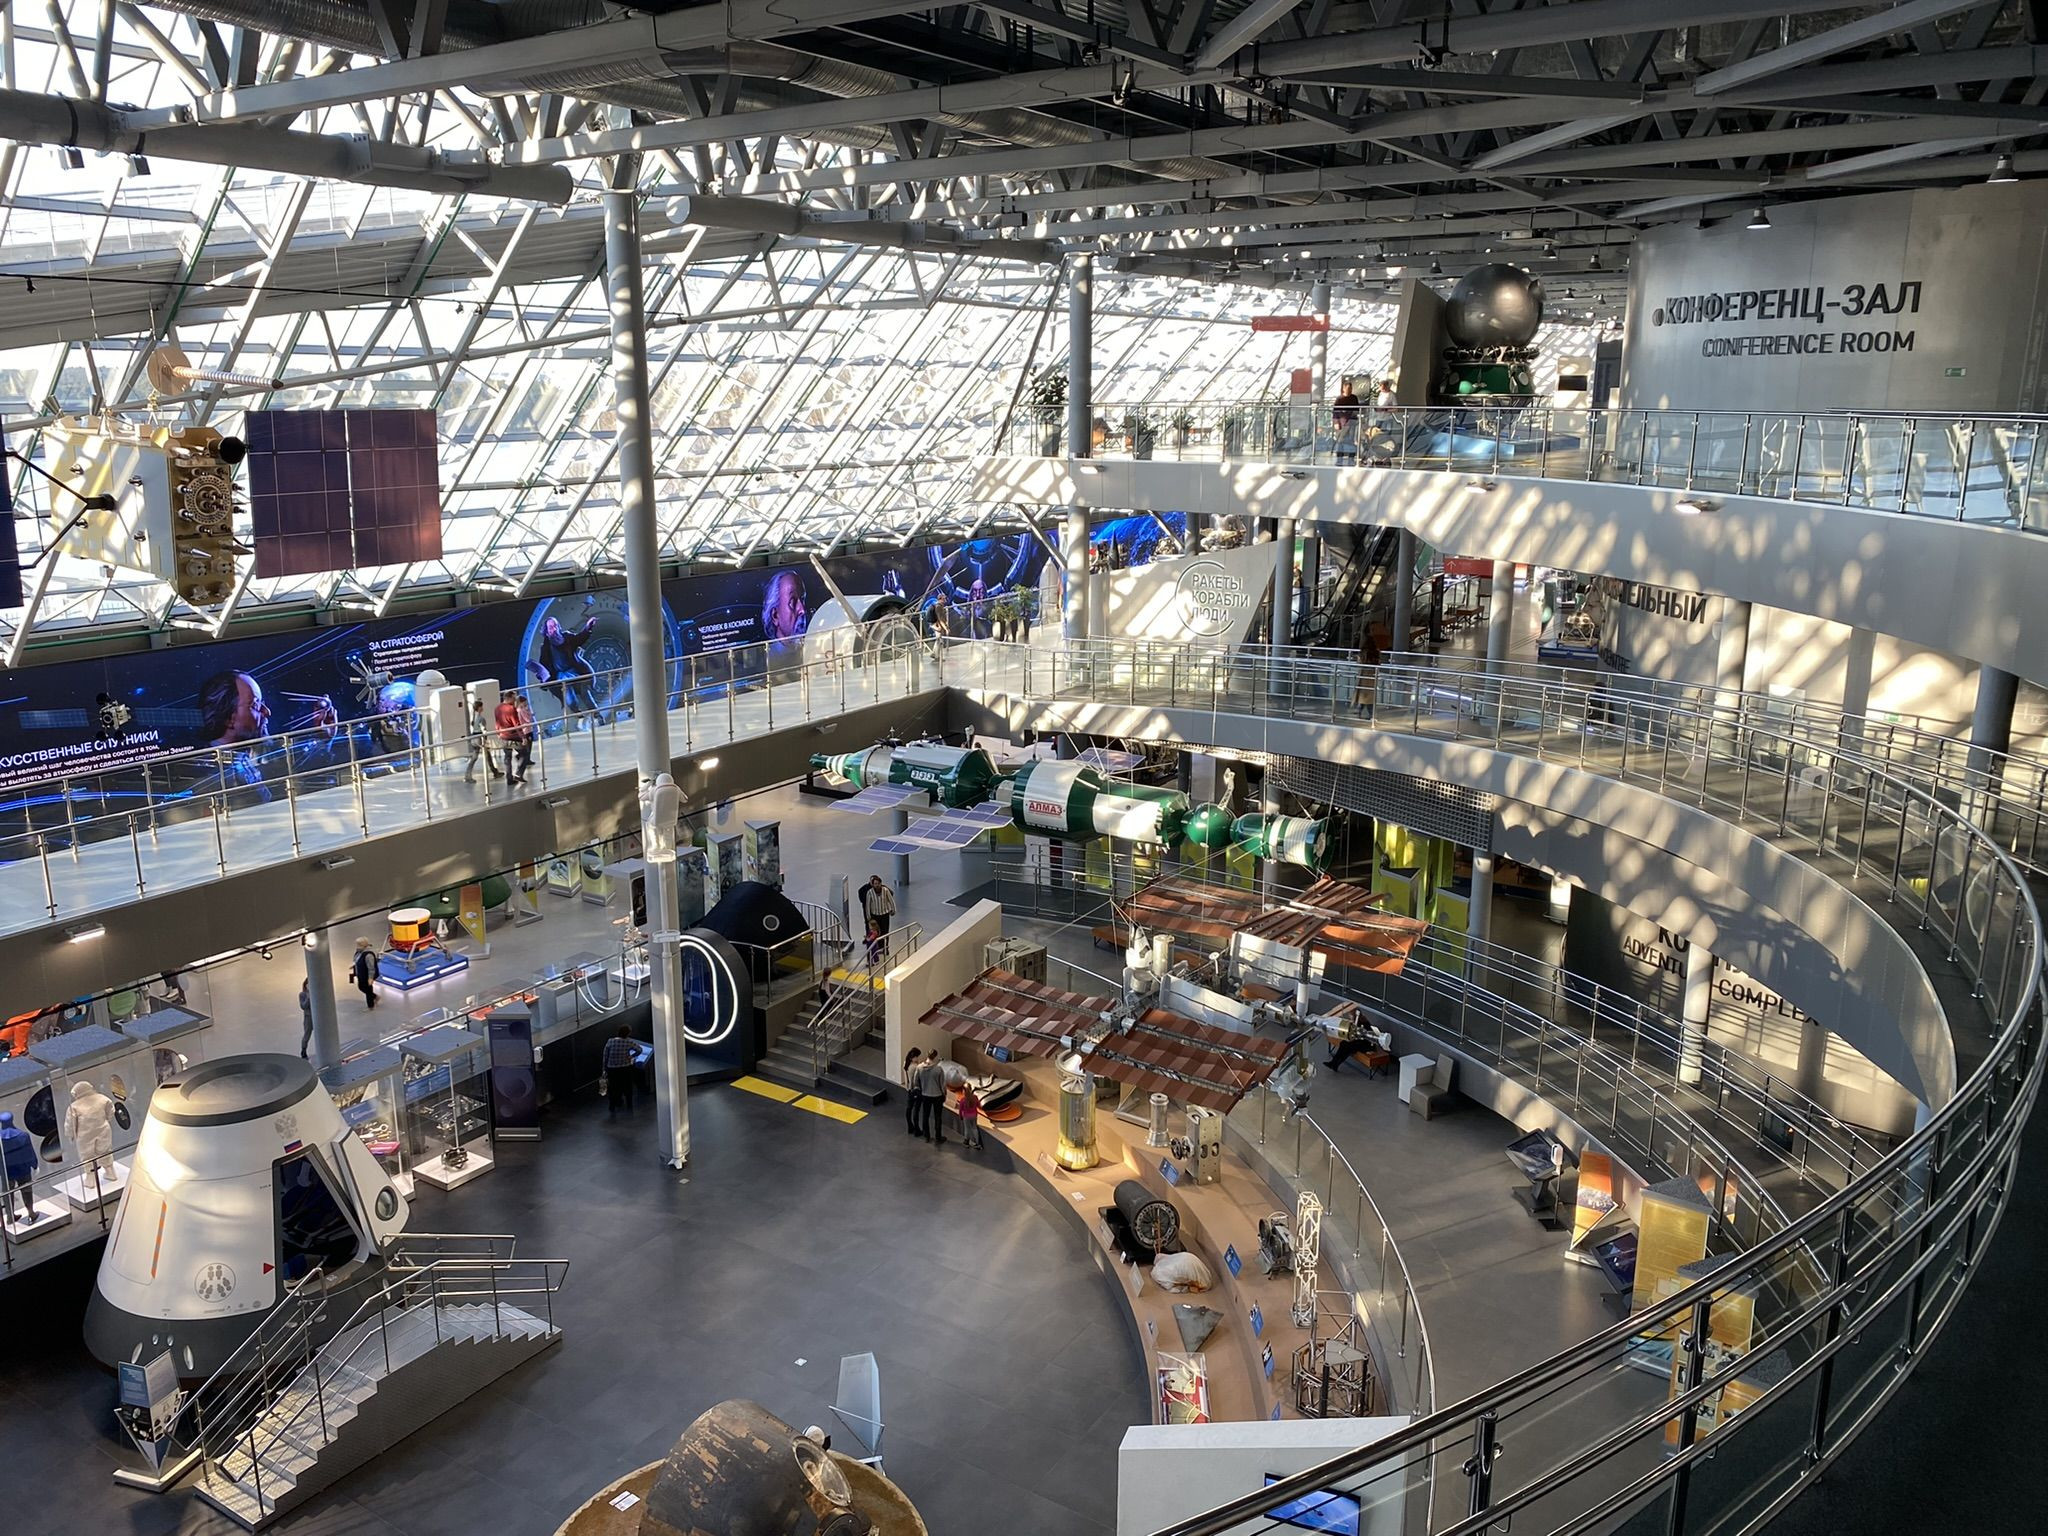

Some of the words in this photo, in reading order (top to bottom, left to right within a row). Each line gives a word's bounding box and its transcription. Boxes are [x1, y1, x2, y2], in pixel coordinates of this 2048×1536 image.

[1664, 281, 1922, 325] КОНФЕРЕНЦ-ЗАЛ
[1702, 333, 1835, 357] CONFERENCE
[1839, 331, 1915, 353] ROOM
[1192, 574, 1243, 590] РАКЕТЫ
[1192, 590, 1249, 607] КОРАБЛИ
[1192, 607, 1229, 623] ЛЮДИ
[369, 641, 380, 651] ЗА
[381, 631, 444, 648] СТРАТОСФЕРОЙ
[17, 764, 48, 776] великий
[49, 762, 62, 770] шаг
[64, 753, 111, 766] человечества
[112, 748, 139, 757] состоит
[53, 765, 92, 777] атмосферу
[99, 757, 134, 768] сделаться
[135, 750, 169, 761] спутником
[1029, 802, 1062, 815] АЛМАЗ
[1623, 936, 1687, 980] ADVENTU
